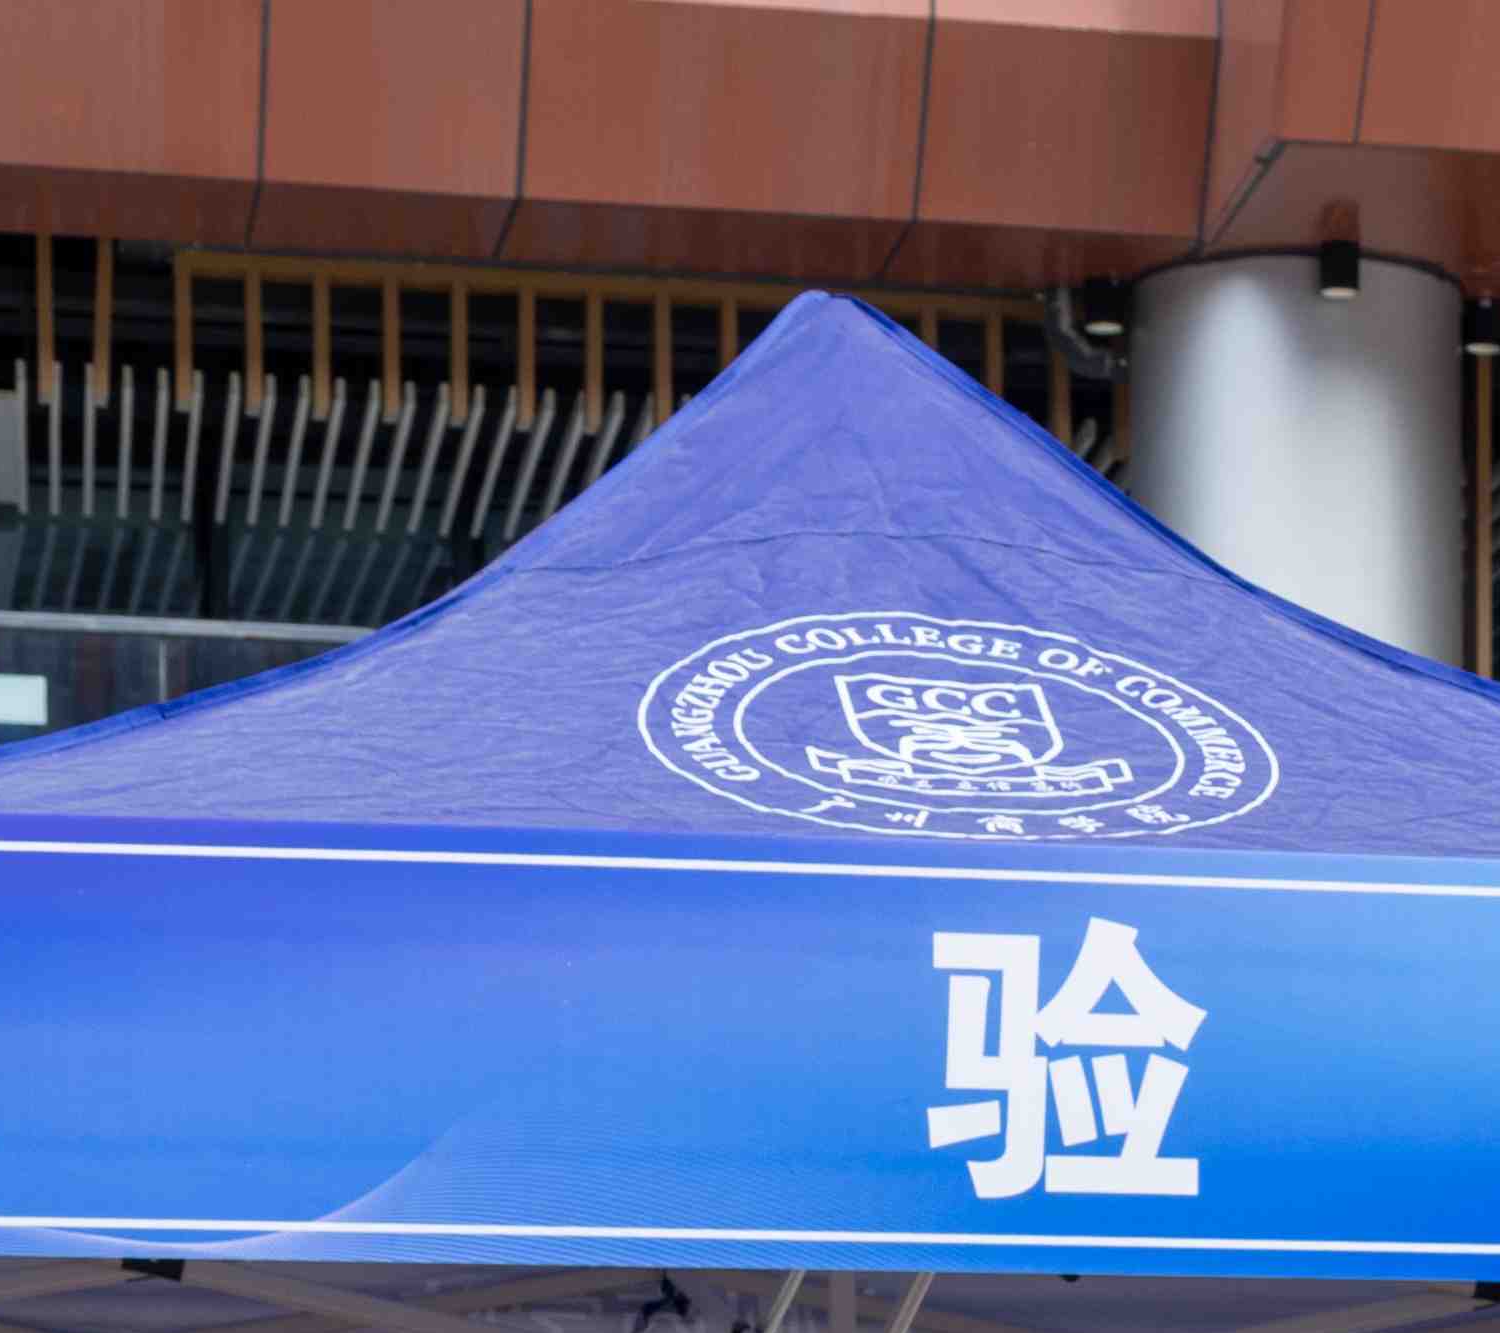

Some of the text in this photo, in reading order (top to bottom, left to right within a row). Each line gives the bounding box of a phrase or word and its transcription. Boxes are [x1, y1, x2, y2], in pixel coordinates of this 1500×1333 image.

[670, 624, 1247, 800] GUANGZHOU COLLEGE OF COMMERCE
[866, 684, 1021, 719] GCC
